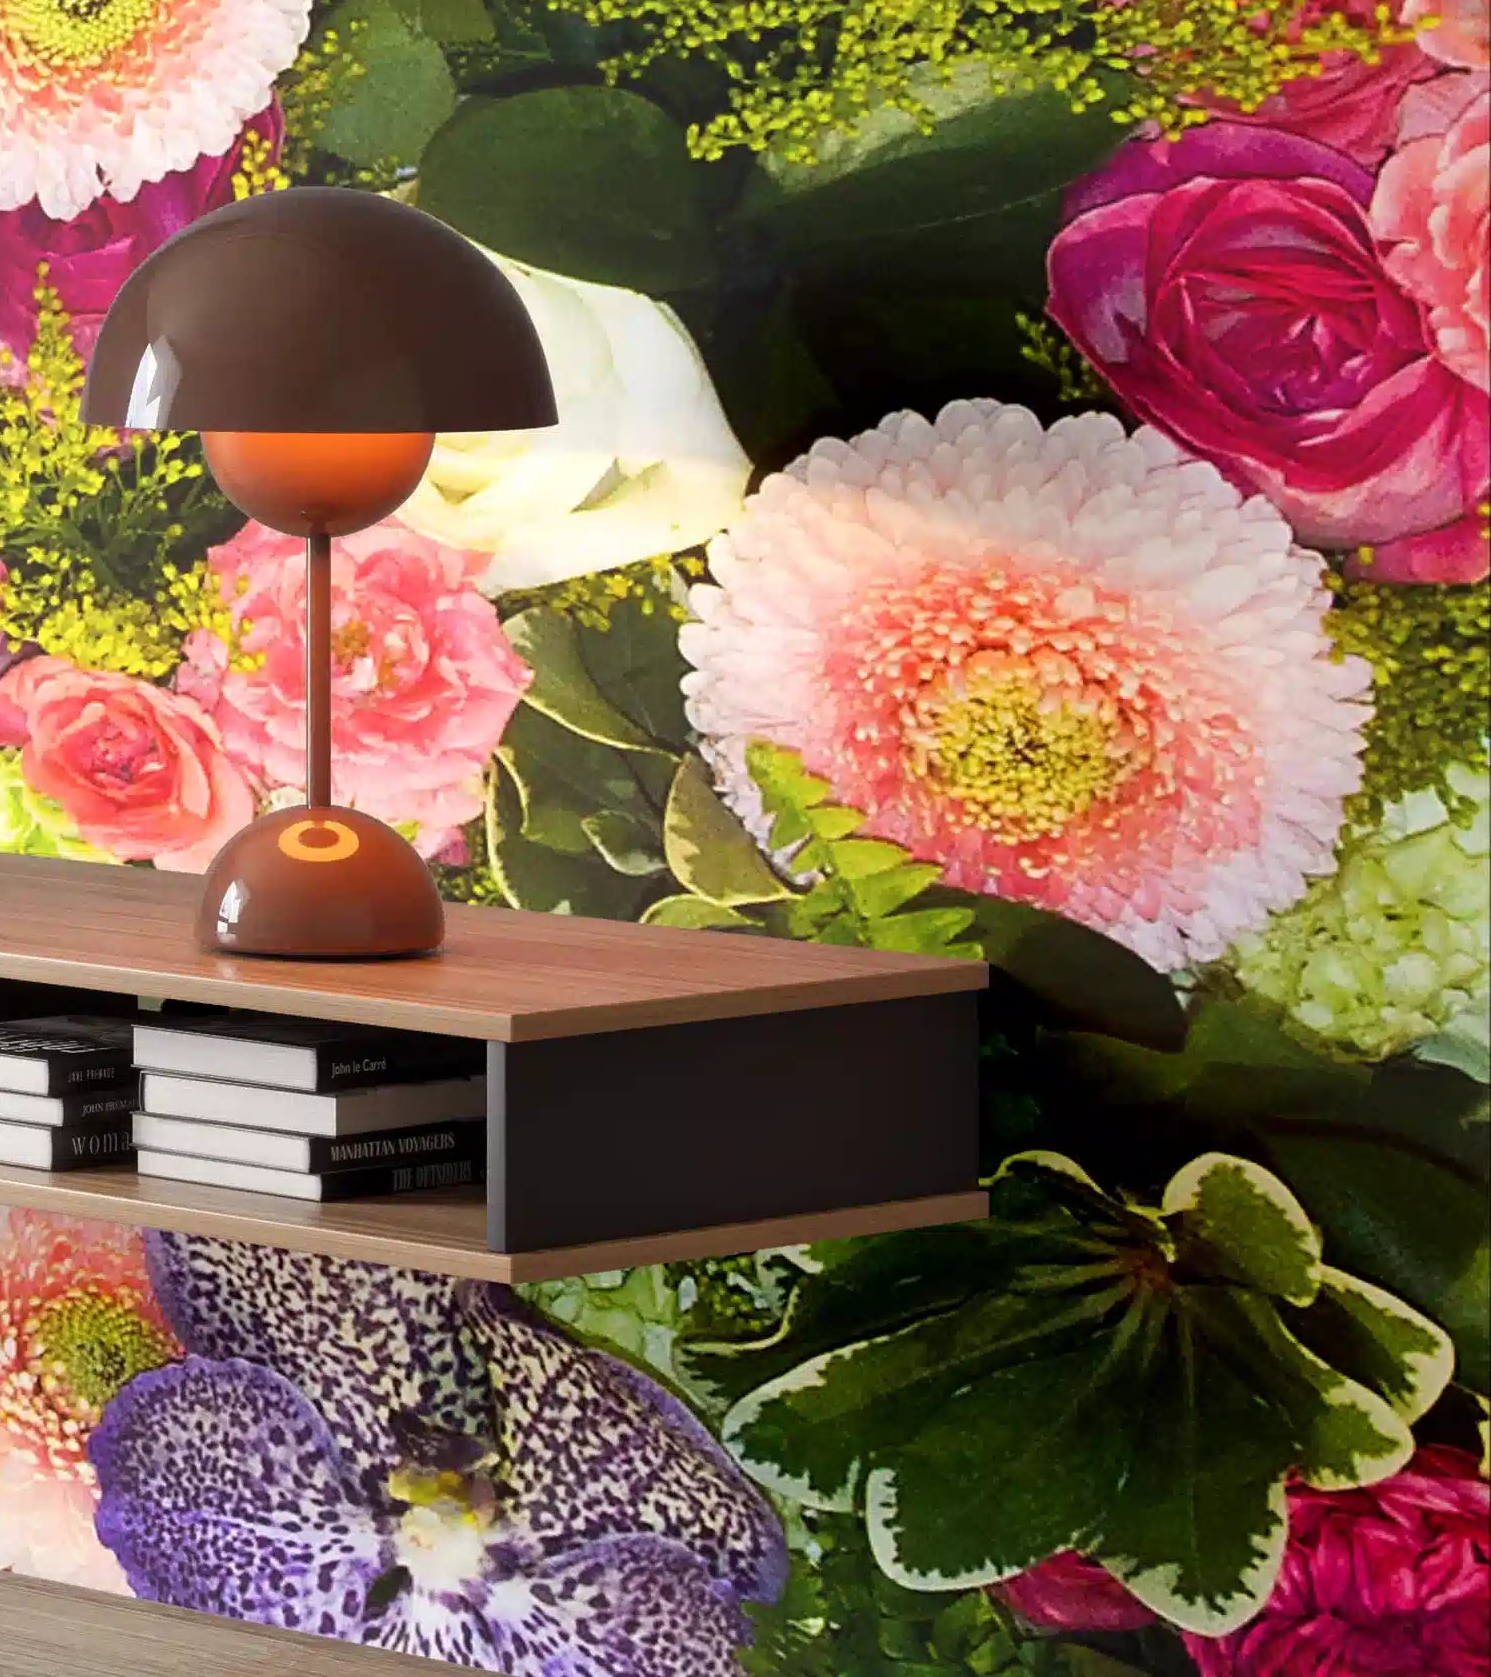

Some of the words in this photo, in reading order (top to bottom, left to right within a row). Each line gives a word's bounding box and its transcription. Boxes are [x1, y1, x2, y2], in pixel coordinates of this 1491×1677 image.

[331, 1061, 351, 1079] John
[353, 1060, 362, 1074] le
[81, 1102, 103, 1118] JOHN
[71, 1131, 131, 1156] woma
[331, 1139, 396, 1161] MANHATTAN
[398, 1131, 455, 1154] VOYAGERS
